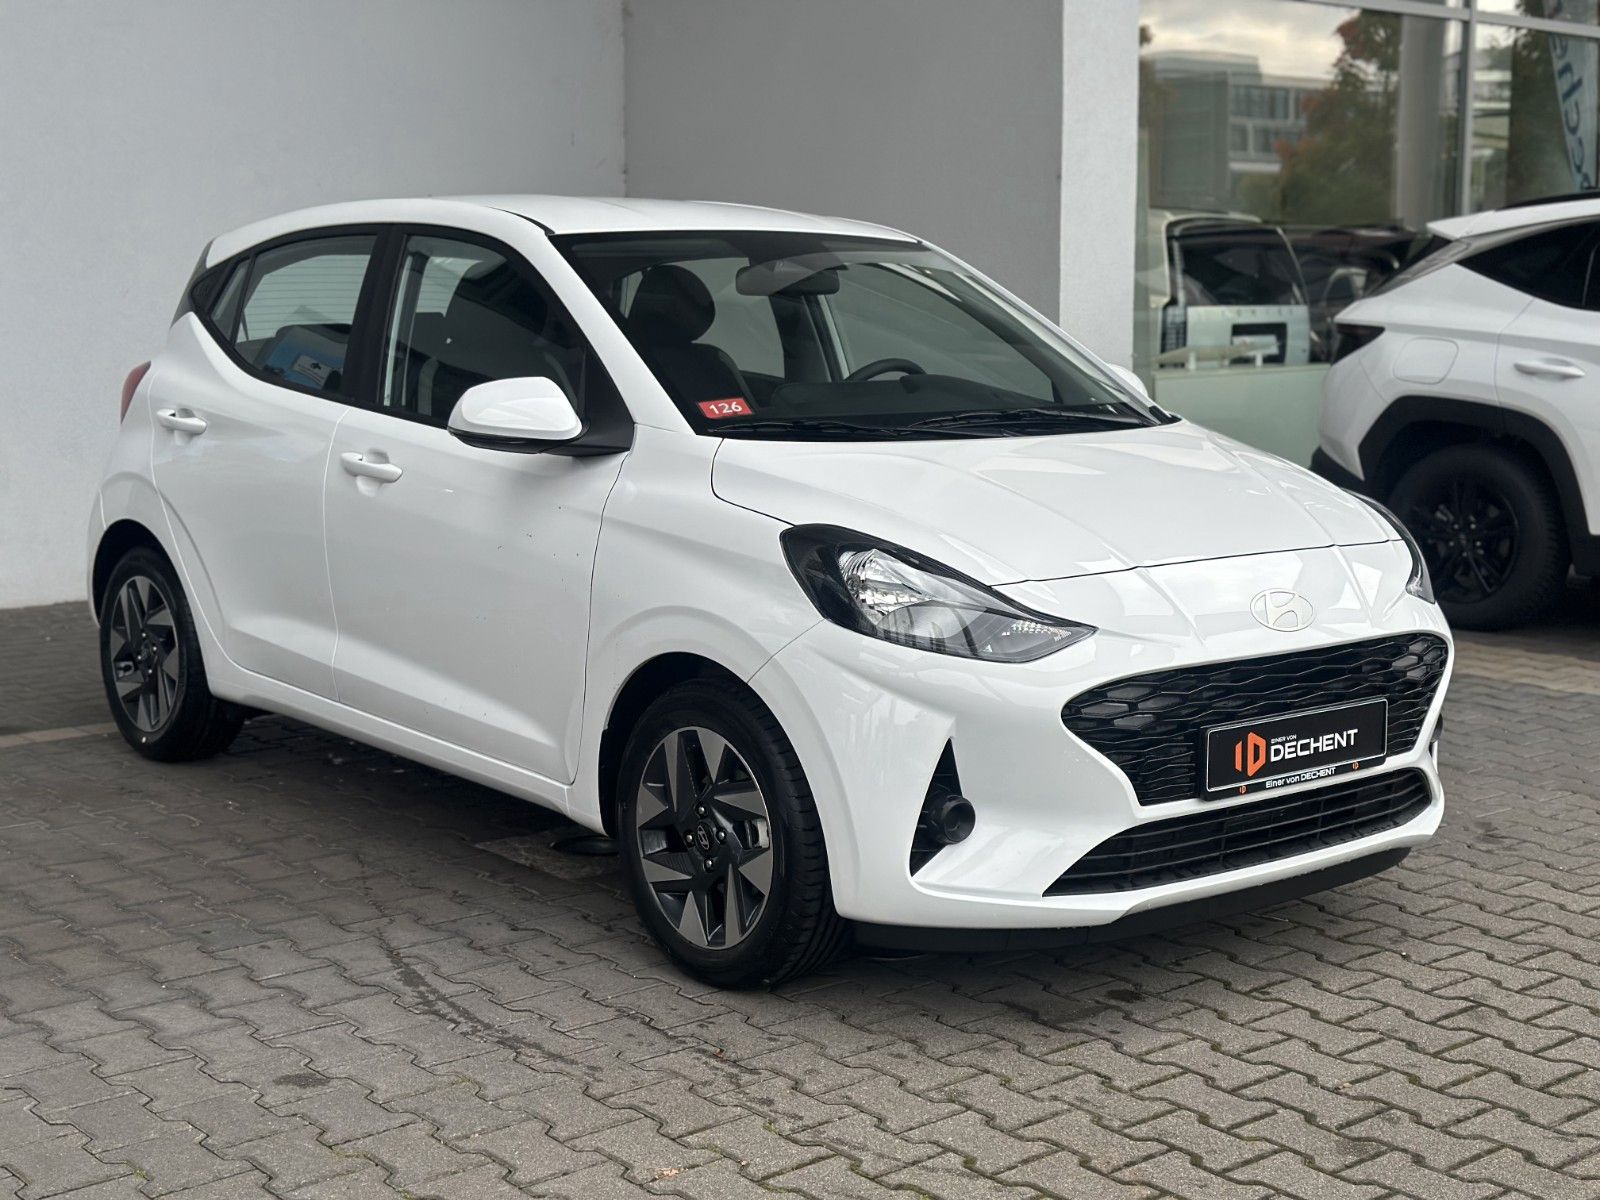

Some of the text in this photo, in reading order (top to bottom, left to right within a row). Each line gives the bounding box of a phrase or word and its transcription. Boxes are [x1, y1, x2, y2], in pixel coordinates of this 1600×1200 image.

[709, 401, 743, 415] 126
[1270, 736, 1286, 744] EINER
[1270, 728, 1359, 763] DECHENT
[1265, 767, 1337, 789] Einer von DECHENT
